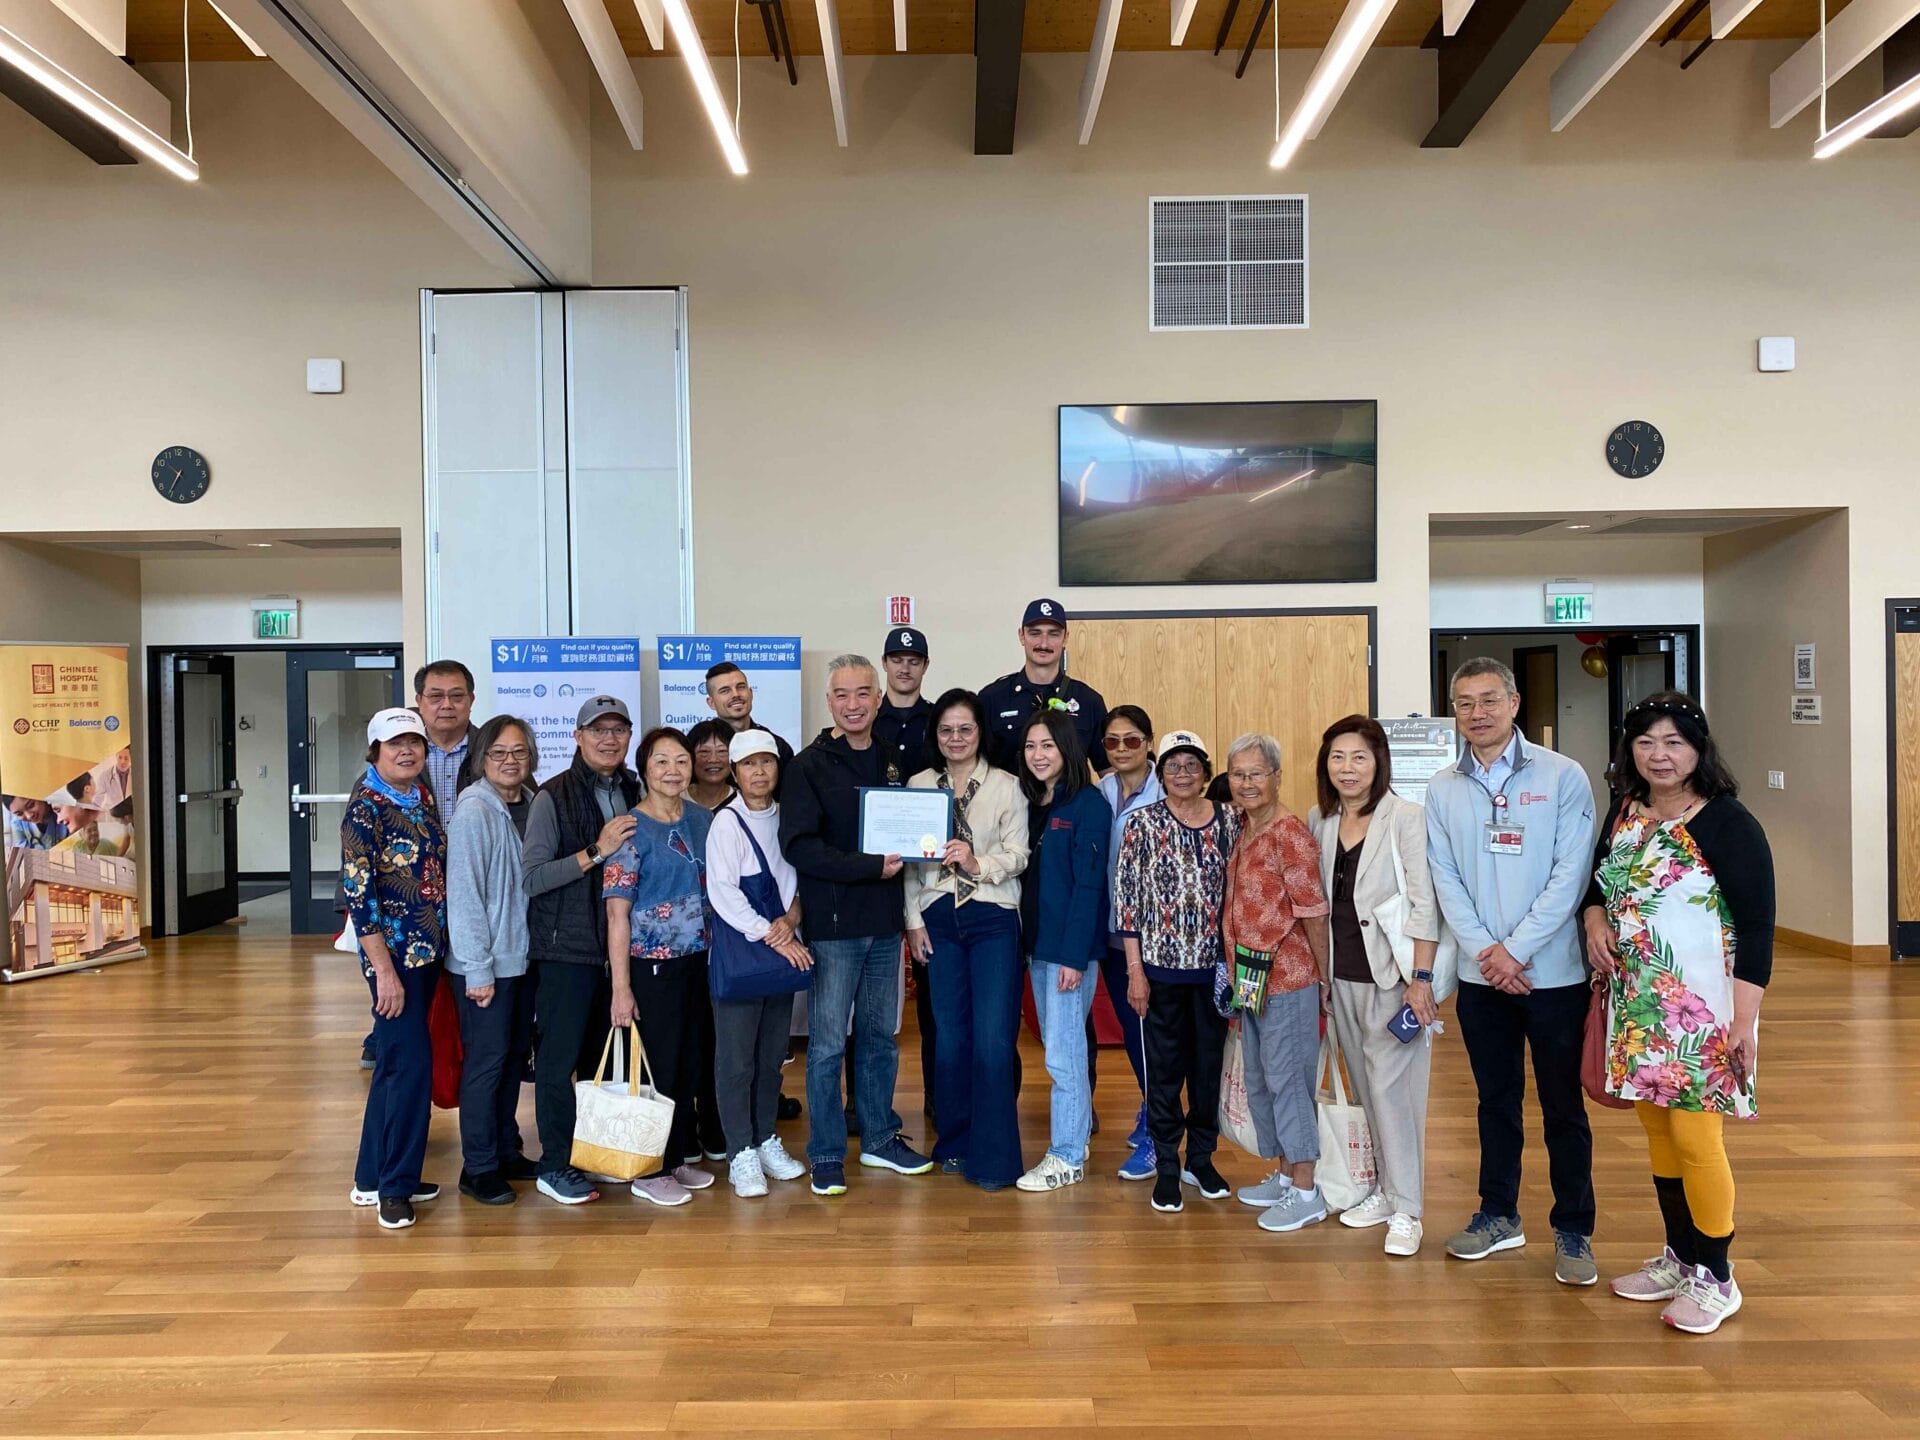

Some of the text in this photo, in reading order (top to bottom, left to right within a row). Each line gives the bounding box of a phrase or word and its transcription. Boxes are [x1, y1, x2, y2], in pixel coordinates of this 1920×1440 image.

[1614, 433, 1622, 441] 10
[157, 459, 165, 467] 10
[1556, 597, 1584, 619] EXIT
[262, 614, 290, 635] EXIT
[611, 644, 634, 652] qualify
[696, 643, 712, 651] Mo.
[531, 655, 548, 663] 月費
[666, 714, 702, 724] Quality
[1793, 711, 1803, 720] 190
[69, 719, 101, 727] Balance
[529, 717, 538, 725] at
[542, 716, 558, 725] the
[535, 730, 574, 738] commu
